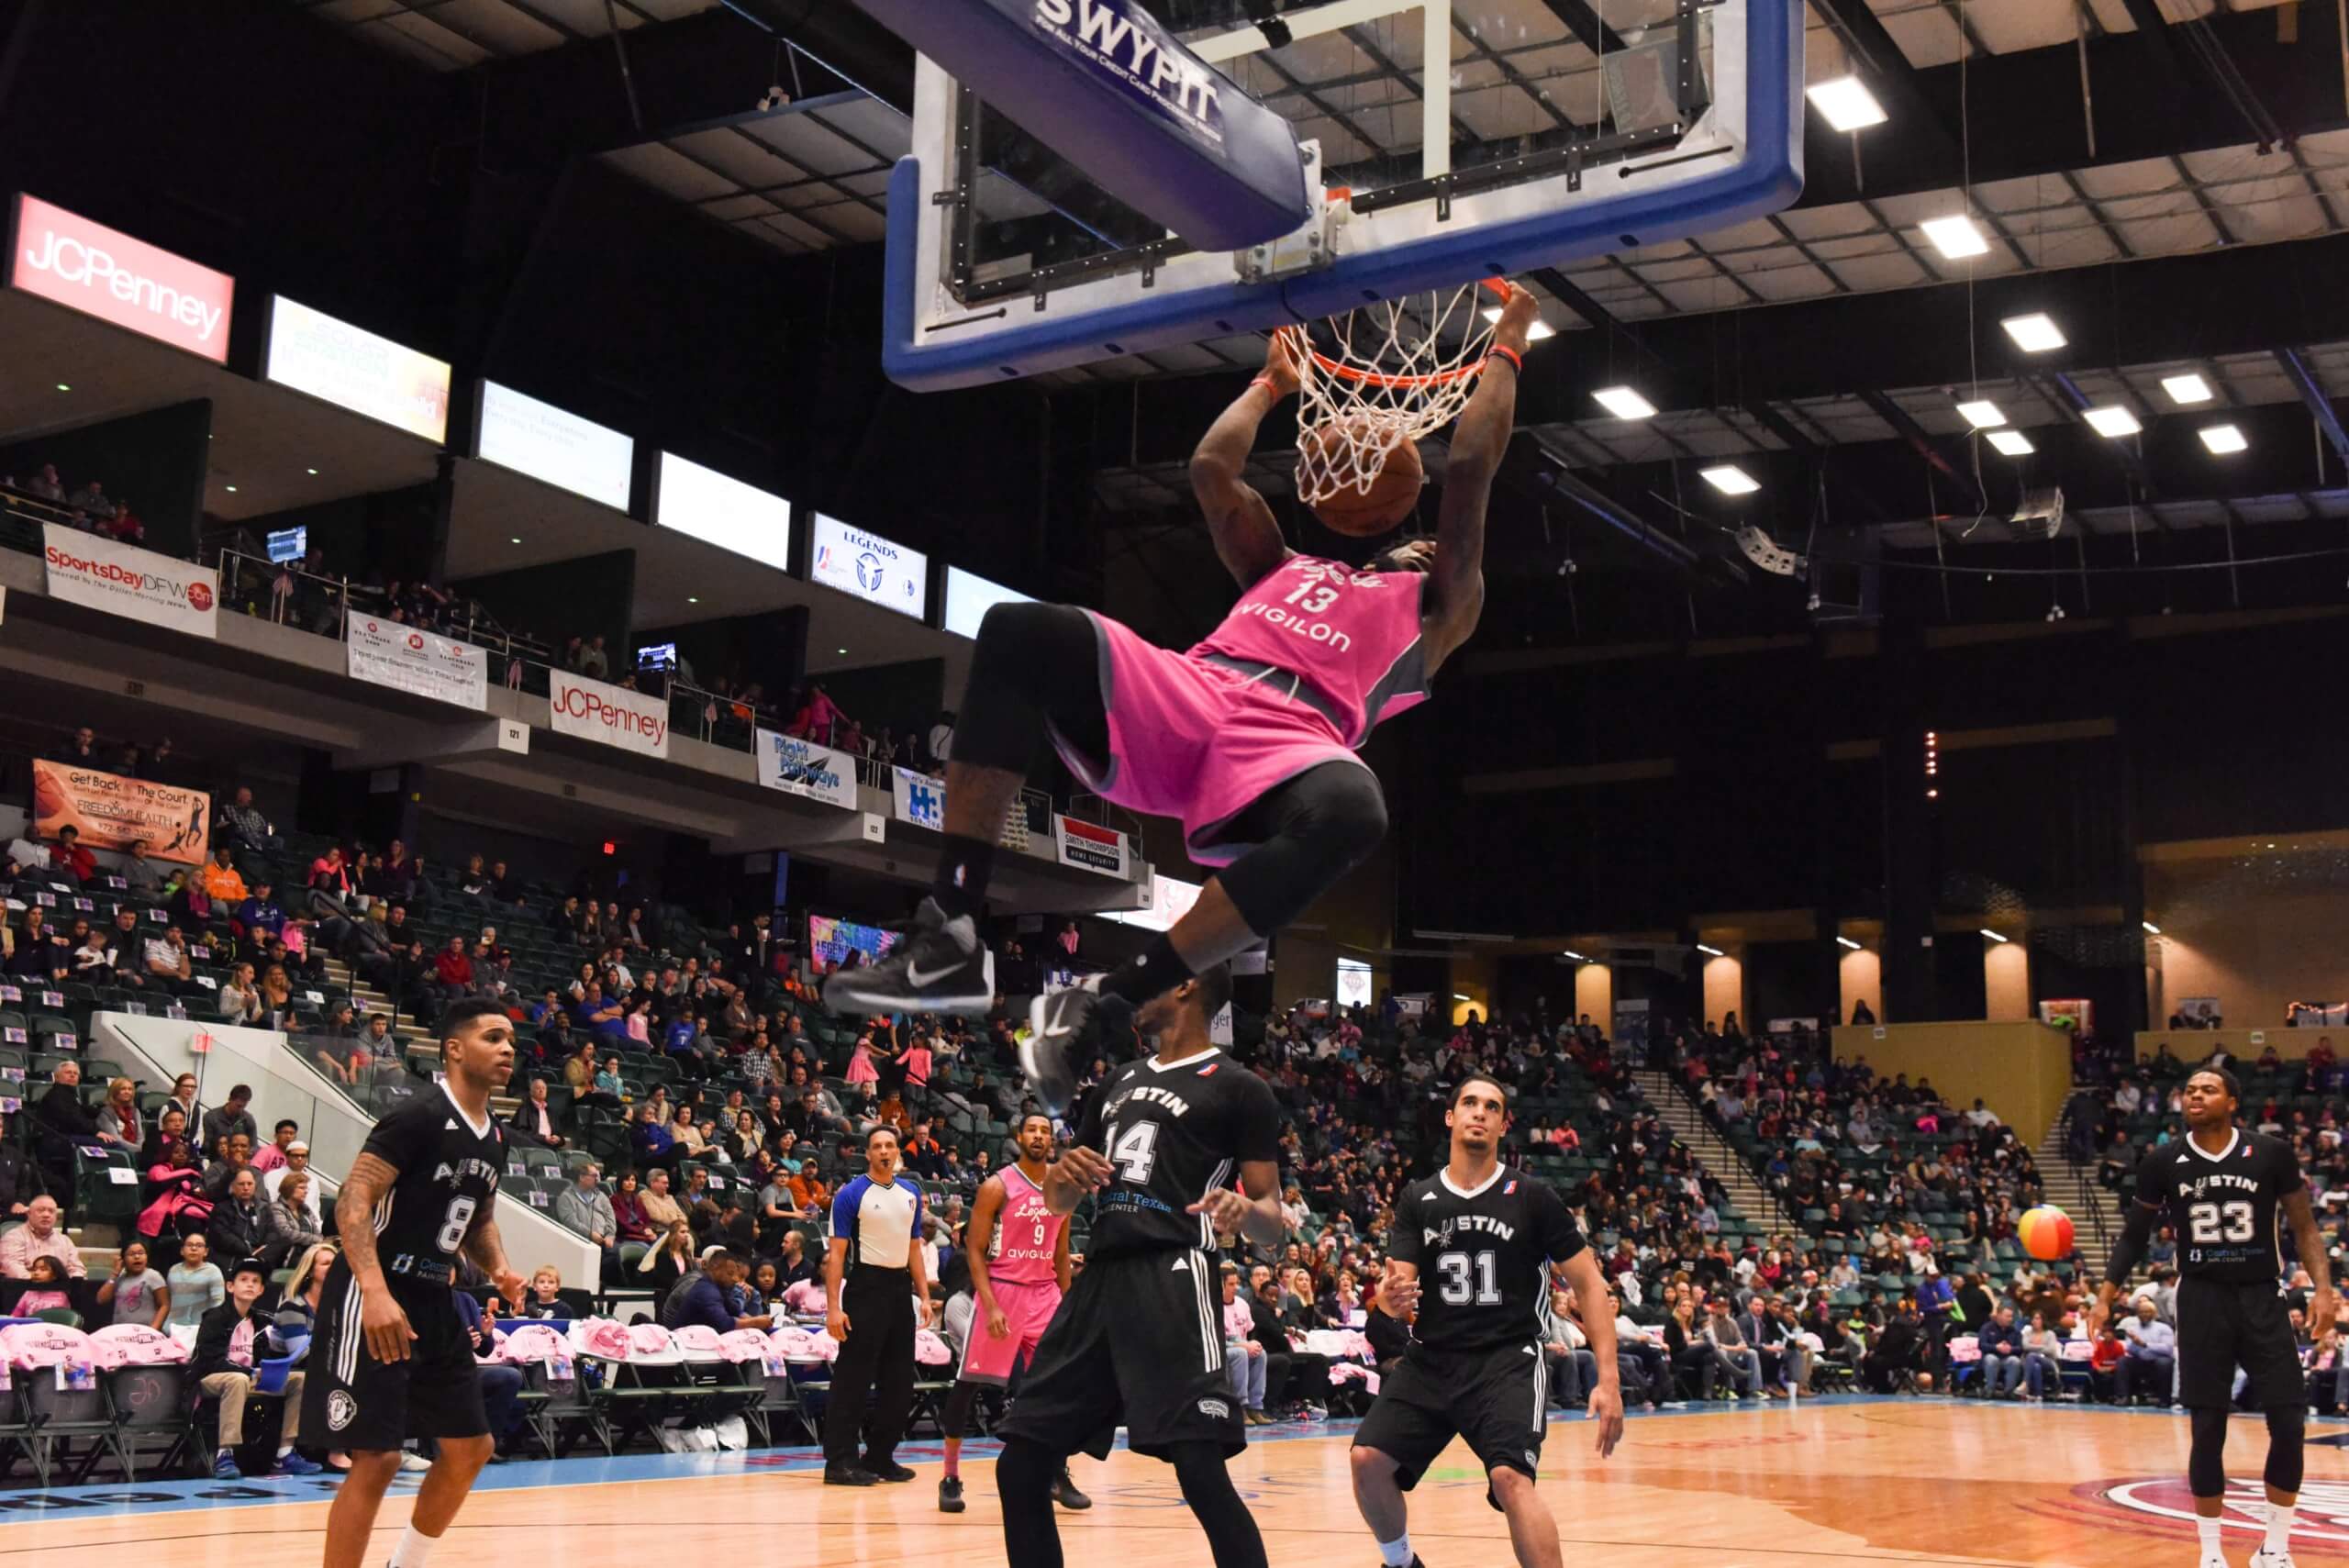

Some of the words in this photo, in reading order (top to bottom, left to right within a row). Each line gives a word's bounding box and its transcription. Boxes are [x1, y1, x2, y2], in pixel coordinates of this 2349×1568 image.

[1037, 0, 1221, 122] SWYPIT
[1098, 55, 1130, 80] CREDIT
[1128, 73, 1152, 96] CARD
[26, 230, 222, 340] JCPenney
[843, 530, 898, 561] LEGENDS
[166, 599, 187, 610] News
[1283, 580, 1340, 614] 13
[552, 685, 665, 747] JCPenney
[508, 728, 520, 740] 121
[774, 736, 808, 762] Right
[70, 772, 91, 785] Get
[93, 776, 120, 792] Back
[137, 784, 155, 798] The
[779, 755, 840, 789] Pathways
[1064, 834, 1085, 847] SMITH
[1085, 840, 1120, 856] THOMPSON
[1070, 850, 1087, 861] HOME
[1088, 854, 1116, 867] SECURITY
[816, 939, 850, 956] LEGEND
[1212, 1011, 1231, 1029] ger
[1105, 1119, 1160, 1186] 14
[2178, 1174, 2259, 1199] AUSTIN
[1014, 1204, 1052, 1222] Legen
[1132, 1192, 1172, 1214] Texas
[436, 1195, 477, 1254] 8
[1033, 1223, 1045, 1246] 9
[1423, 1215, 1515, 1248] AUSTIN
[2188, 1199, 2255, 1244] 23
[1437, 1249, 1503, 1307] 31
